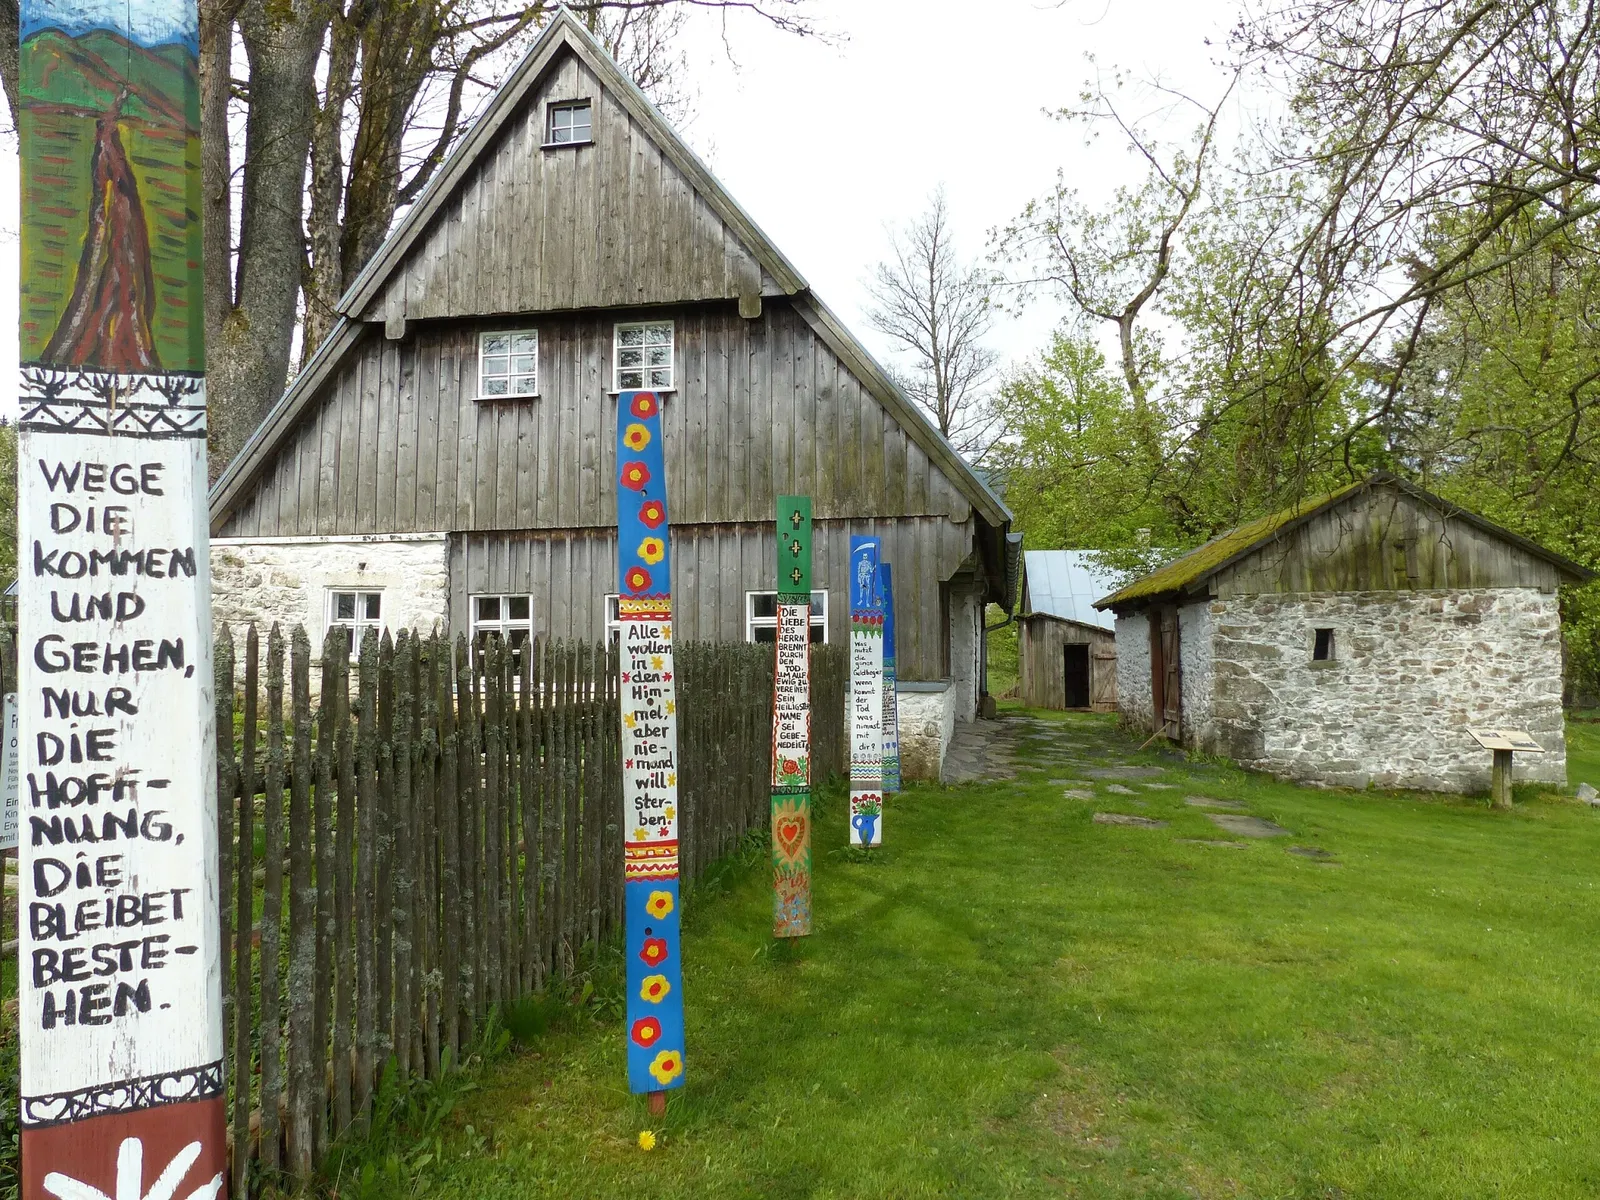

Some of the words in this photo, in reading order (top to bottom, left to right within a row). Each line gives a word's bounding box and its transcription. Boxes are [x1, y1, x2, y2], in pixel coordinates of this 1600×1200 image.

[39, 459, 166, 496] WEGE
[33, 540, 197, 579] KOMMEN
[50, 590, 146, 623] UND
[628, 624, 660, 640] Alle
[780, 626, 796, 634] DES
[778, 634, 805, 643] HERRN
[627, 640, 672, 655] wollen
[778, 643, 807, 651] BRENNT
[779, 651, 804, 659] DURCH
[34, 634, 195, 679] GEHEN,
[631, 655, 647, 670] in
[631, 670, 660, 683] den
[791, 671, 806, 679] AUF
[631, 685, 671, 700] Him-
[855, 696, 868, 704] der
[42, 686, 139, 719] NUR
[855, 703, 870, 712] Tod
[780, 712, 802, 721] NAME
[633, 723, 669, 739] aber
[634, 740, 667, 756] nie-
[636, 750, 674, 770] mand
[635, 772, 667, 790] will
[29, 807, 185, 846] NUNG,
[638, 811, 672, 827] ben.
[32, 933, 199, 989] BESTE-
[42, 978, 172, 1030] HEN.
